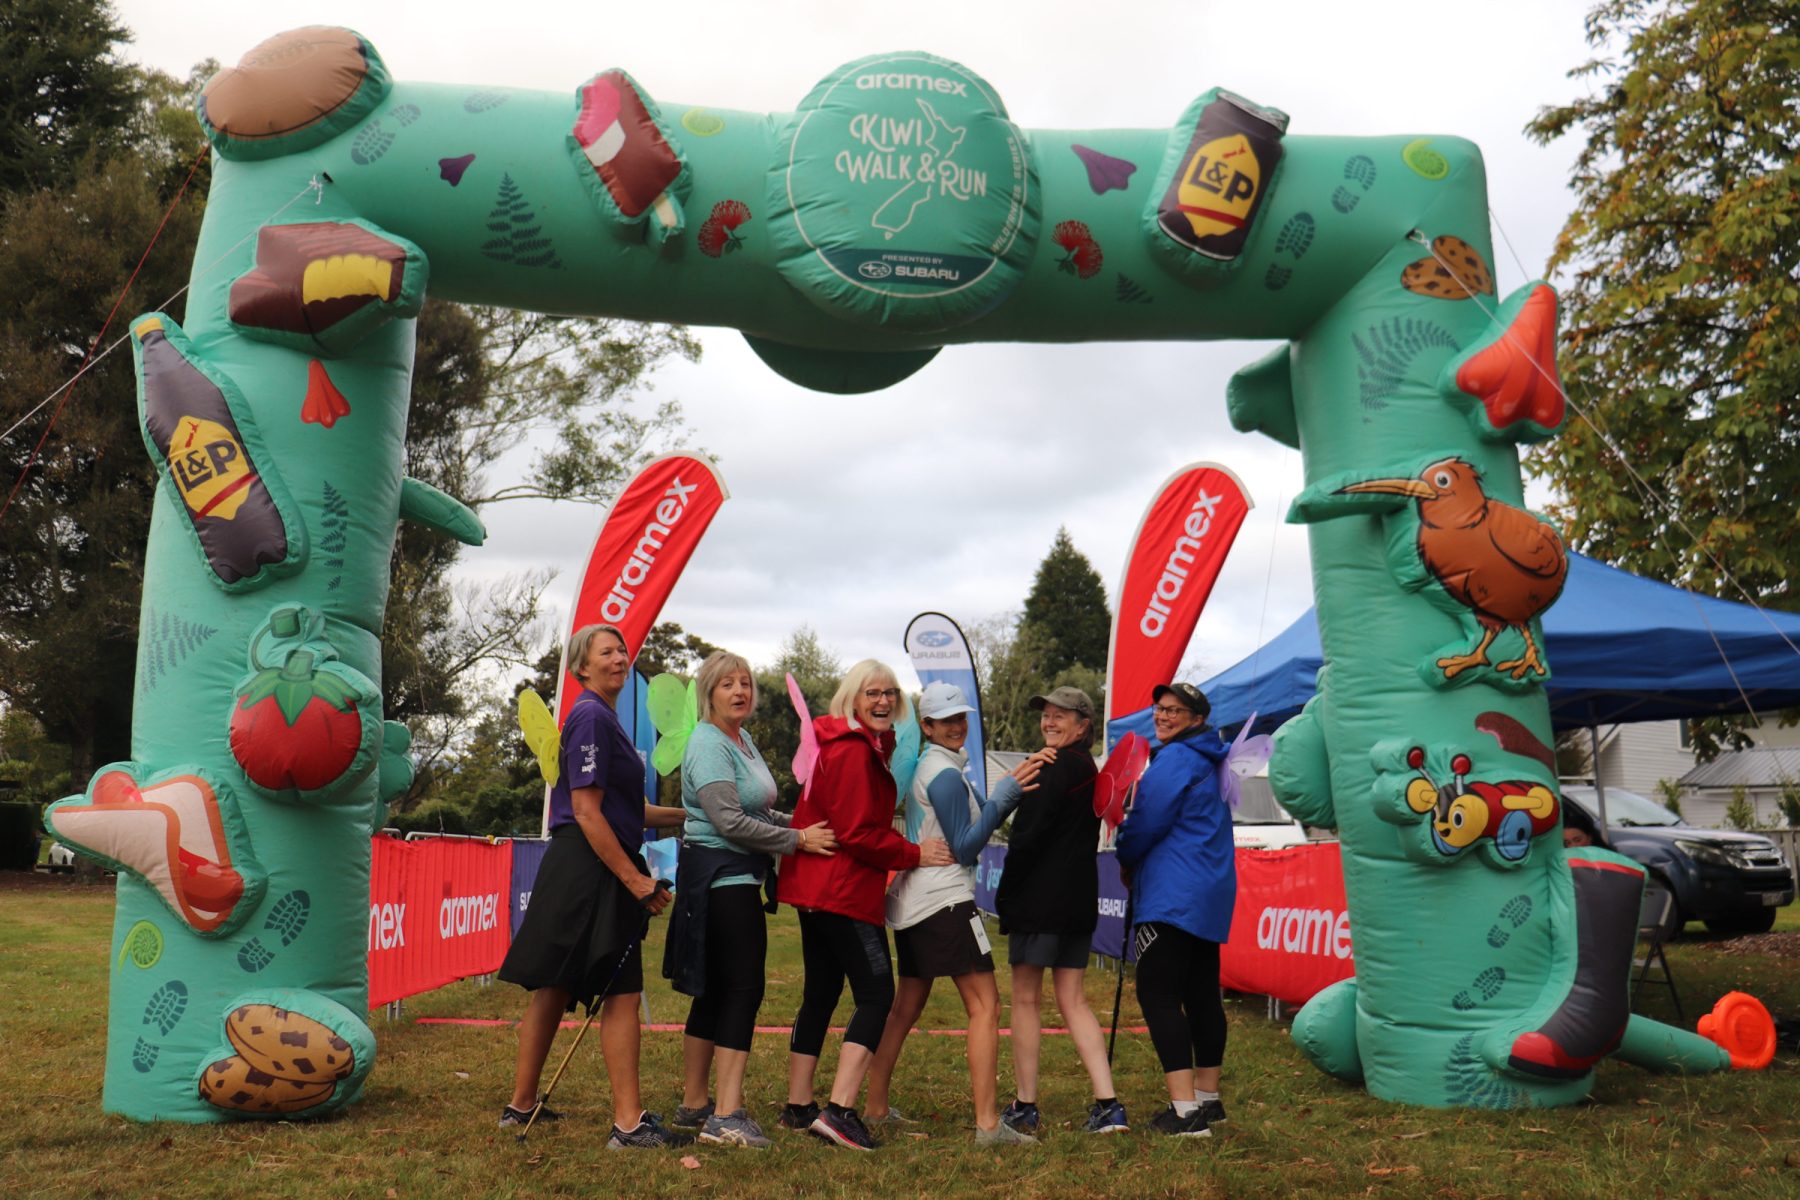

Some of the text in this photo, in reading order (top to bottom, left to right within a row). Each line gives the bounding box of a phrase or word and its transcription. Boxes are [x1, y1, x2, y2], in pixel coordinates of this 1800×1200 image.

[855, 72, 968, 98] aramex
[849, 113, 922, 152] KIWI
[834, 150, 912, 184] WALK
[936, 160, 988, 200] RUN
[1190, 156, 1254, 203] L&P
[881, 253, 944, 265] PRESENTED BY
[894, 265, 960, 281] SUBARU
[174, 439, 238, 492] L&P
[600, 476, 698, 623] aramex
[1139, 487, 1223, 638] aramex
[438, 892, 499, 940] aramex
[1097, 897, 1127, 919] UBARU
[1256, 906, 1354, 960] arame
